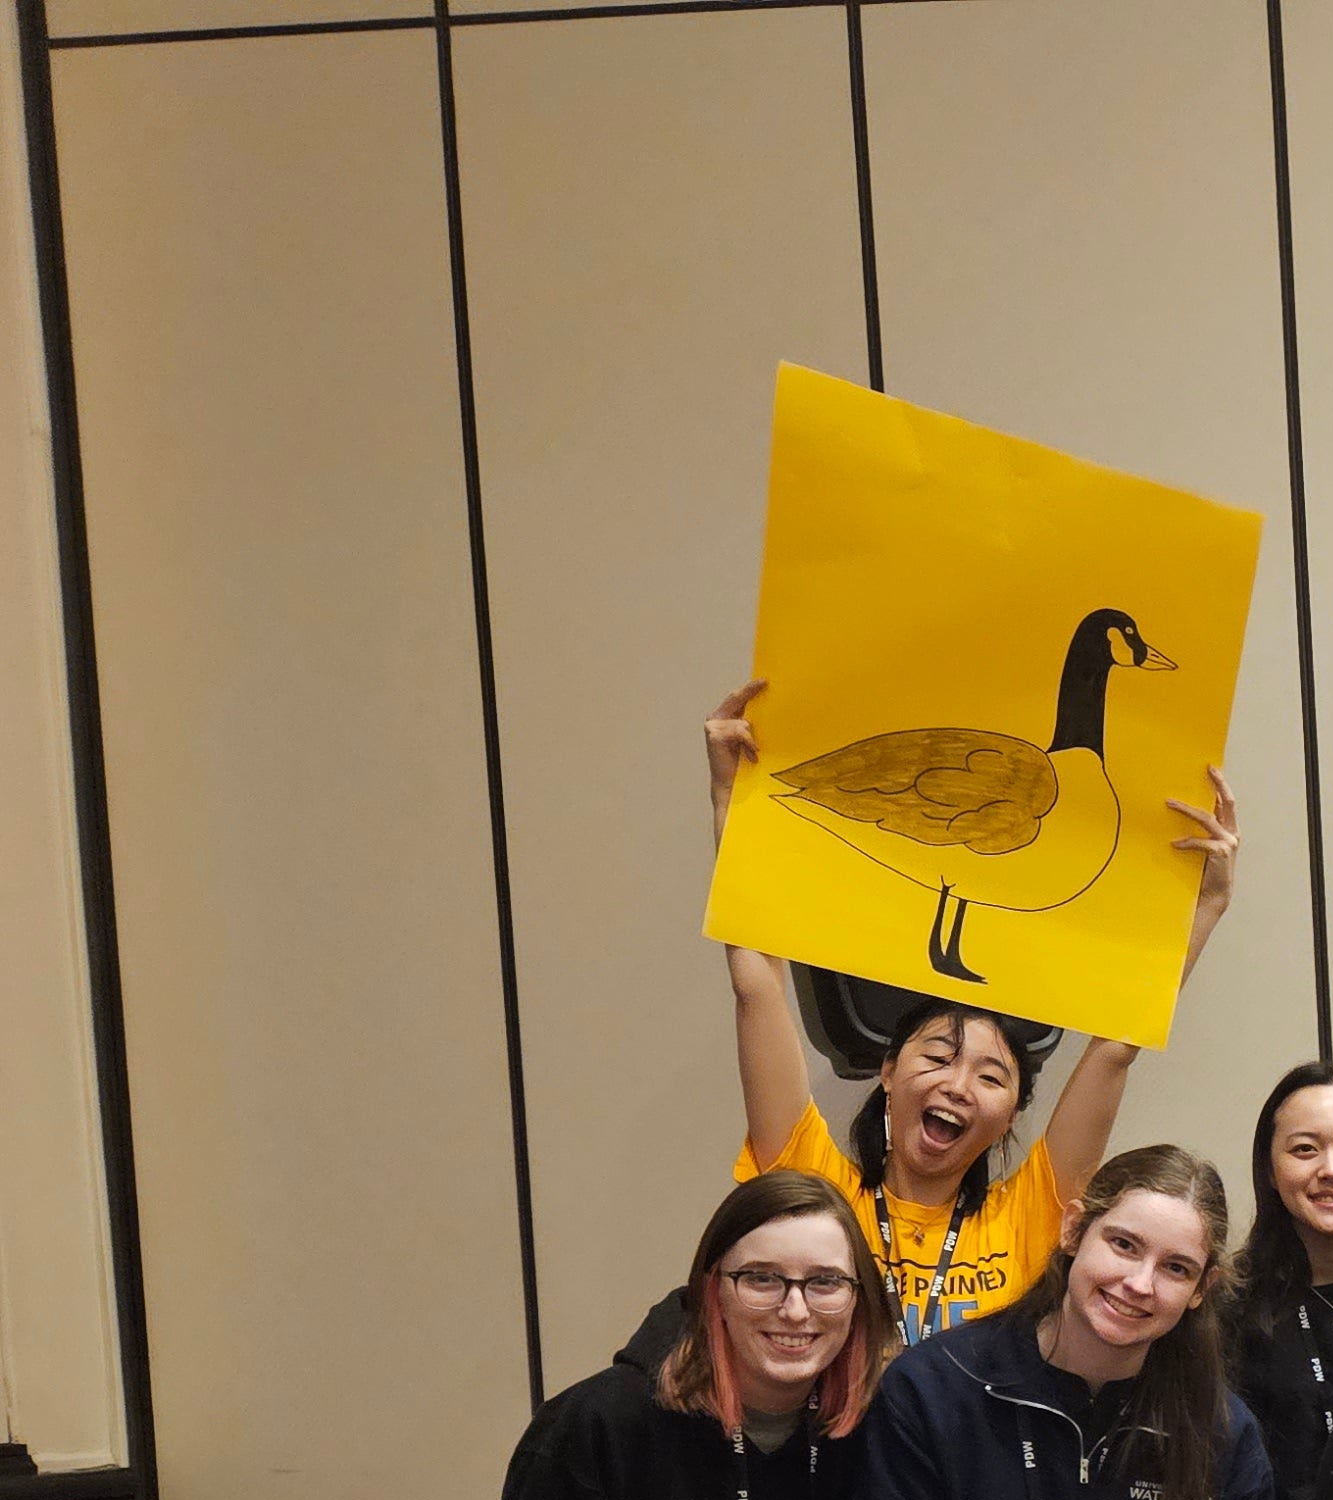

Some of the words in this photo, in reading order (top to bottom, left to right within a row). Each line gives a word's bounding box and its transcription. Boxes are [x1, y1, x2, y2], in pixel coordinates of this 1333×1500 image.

[944, 1231, 957, 1251] PDW
[931, 1275, 944, 1297] PDW
[1311, 1358, 1325, 1382] PDW
[1022, 1441, 1035, 1468] PDW
